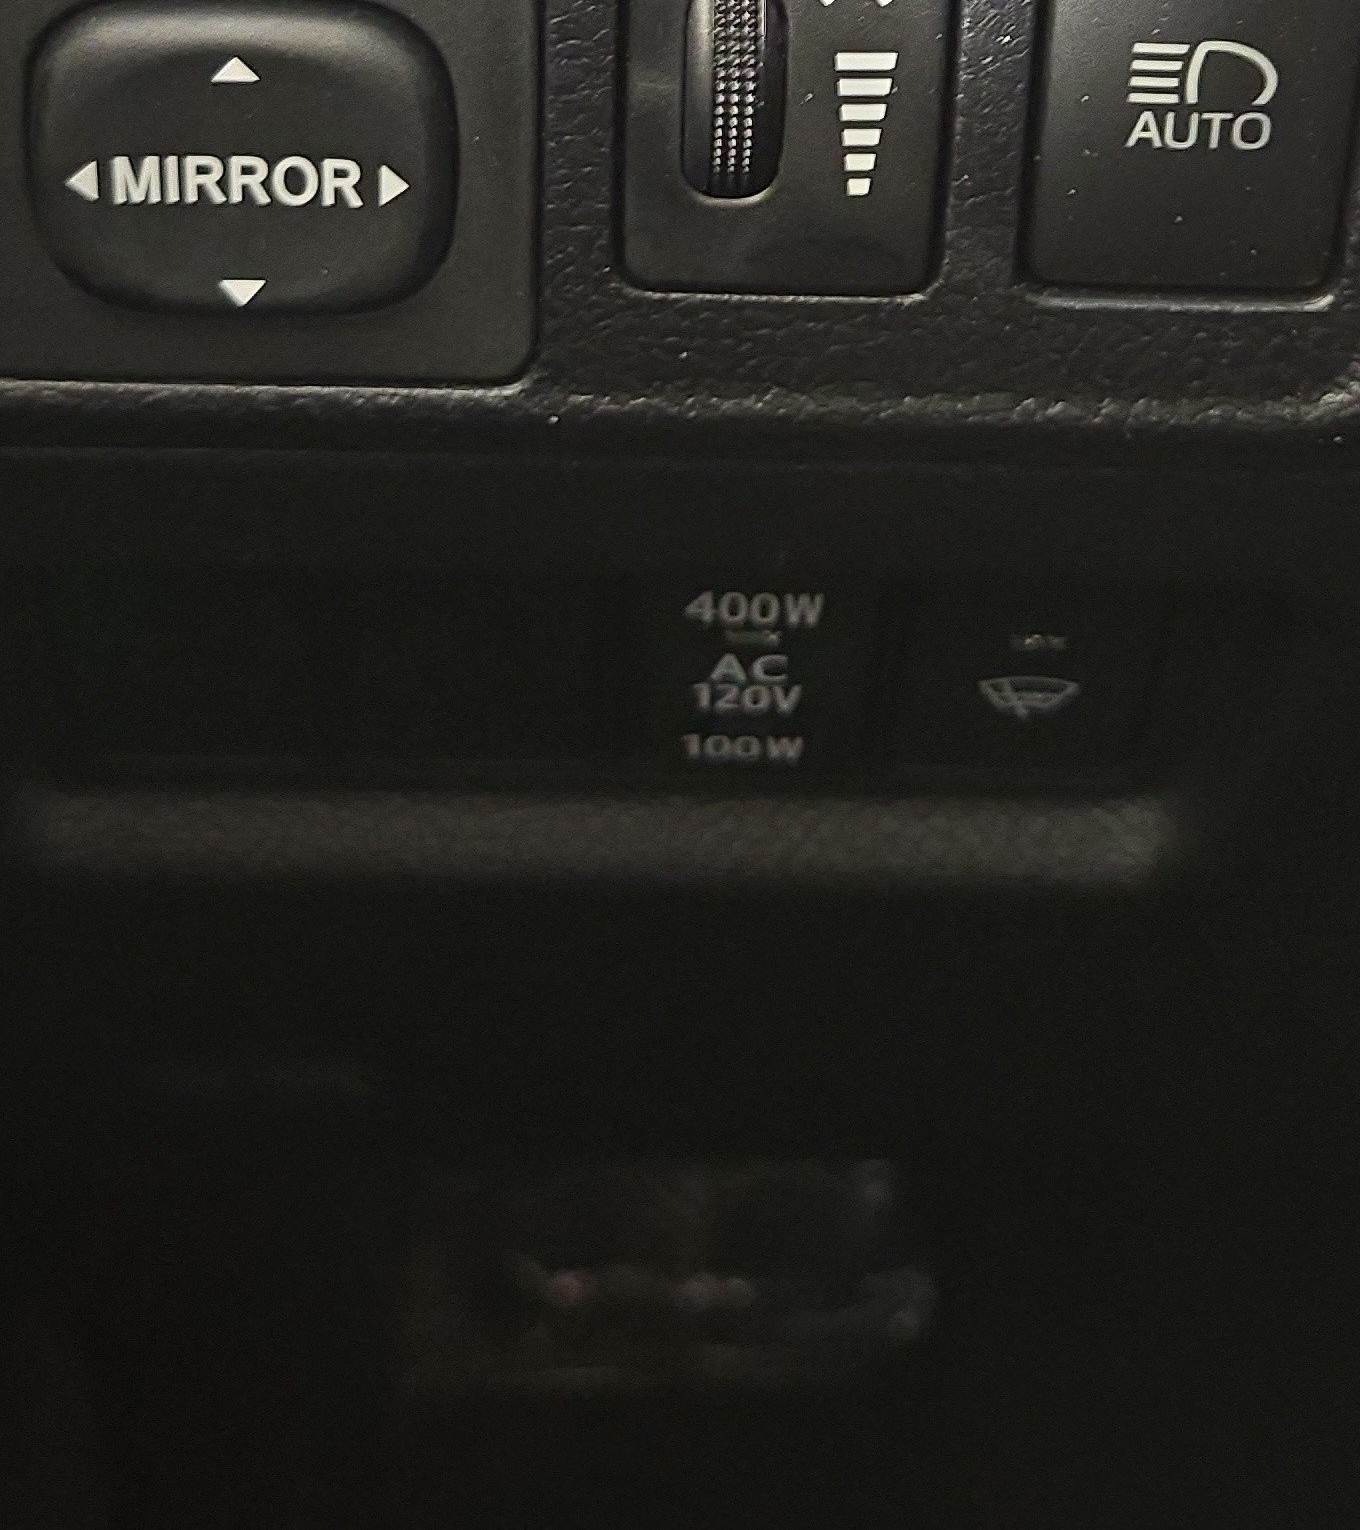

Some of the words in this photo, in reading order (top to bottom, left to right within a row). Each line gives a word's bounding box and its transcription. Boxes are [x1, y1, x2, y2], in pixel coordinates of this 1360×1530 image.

[1125, 108, 1273, 152] AUTO
[110, 154, 364, 209] MIRROR
[684, 590, 825, 628] 400W
[708, 653, 790, 683] AC
[692, 683, 802, 714] 120V
[680, 733, 804, 762] 100W
